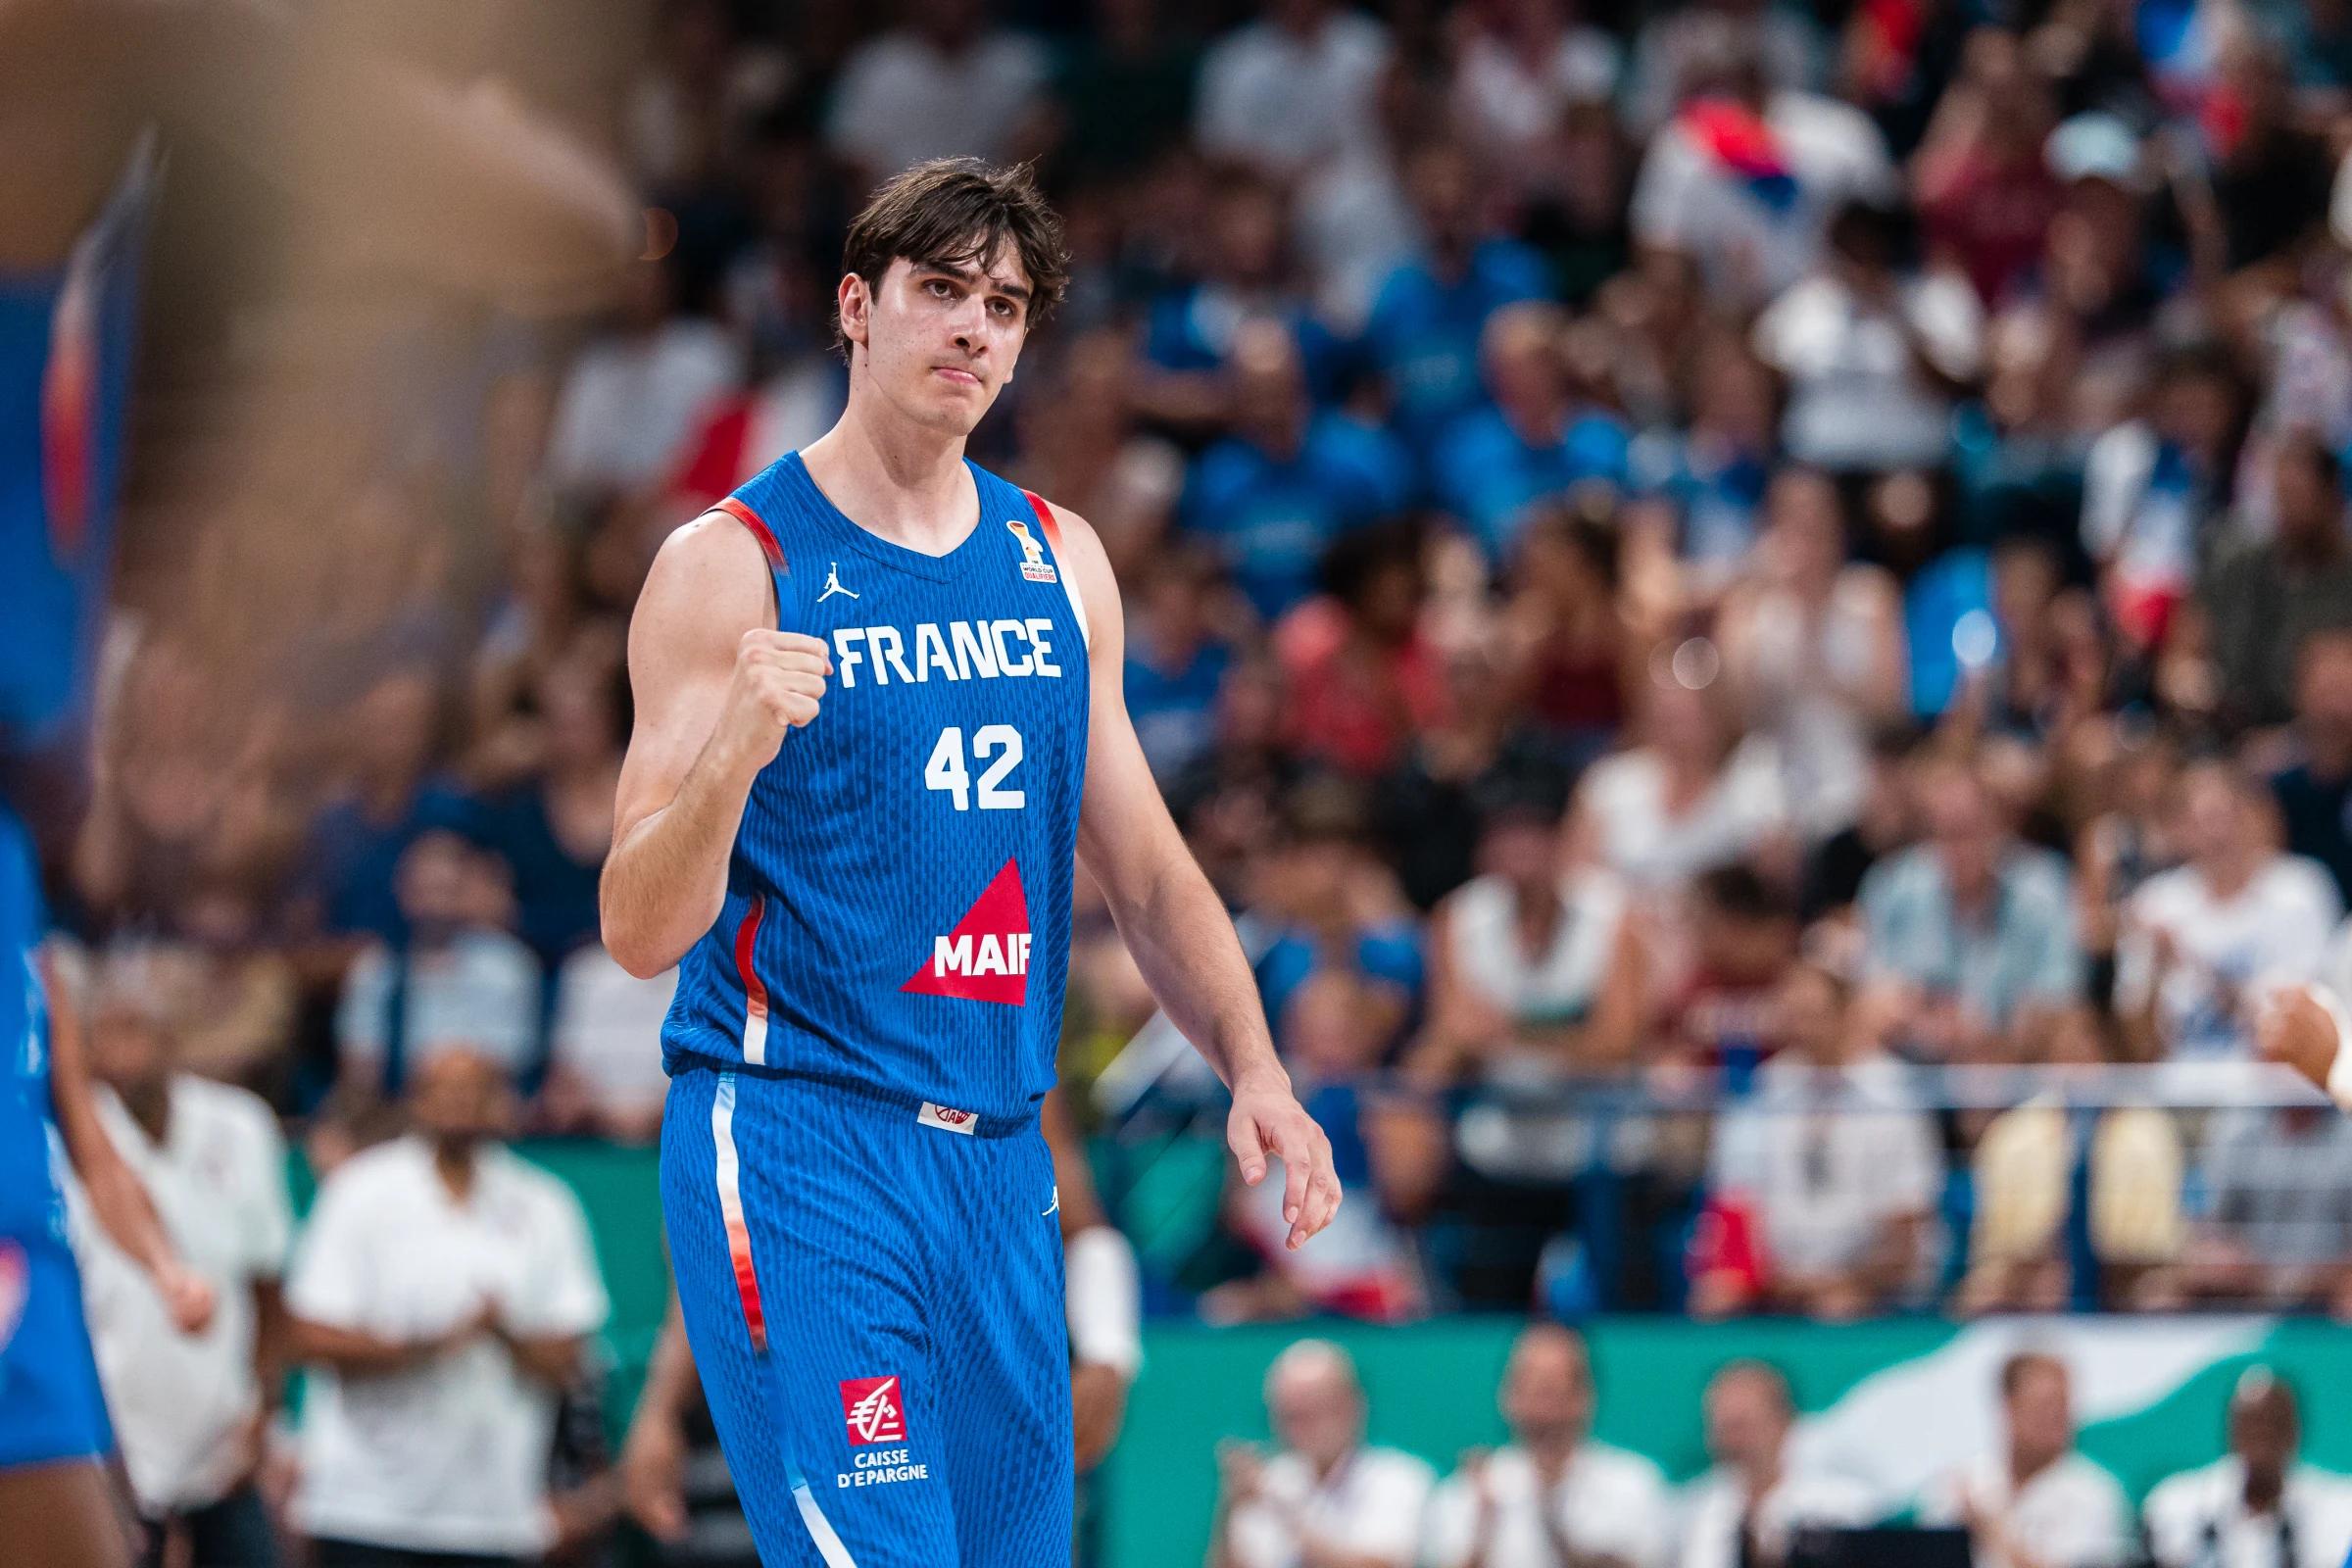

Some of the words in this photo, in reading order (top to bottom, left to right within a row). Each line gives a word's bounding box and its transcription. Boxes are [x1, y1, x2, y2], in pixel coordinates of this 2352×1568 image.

[833, 618, 1061, 688] FRANCE
[924, 724, 1025, 811] 42
[934, 933, 1033, 978] MAIF
[837, 1464, 929, 1489] D'EPARGNE
[854, 1448, 909, 1469] CAISSE
